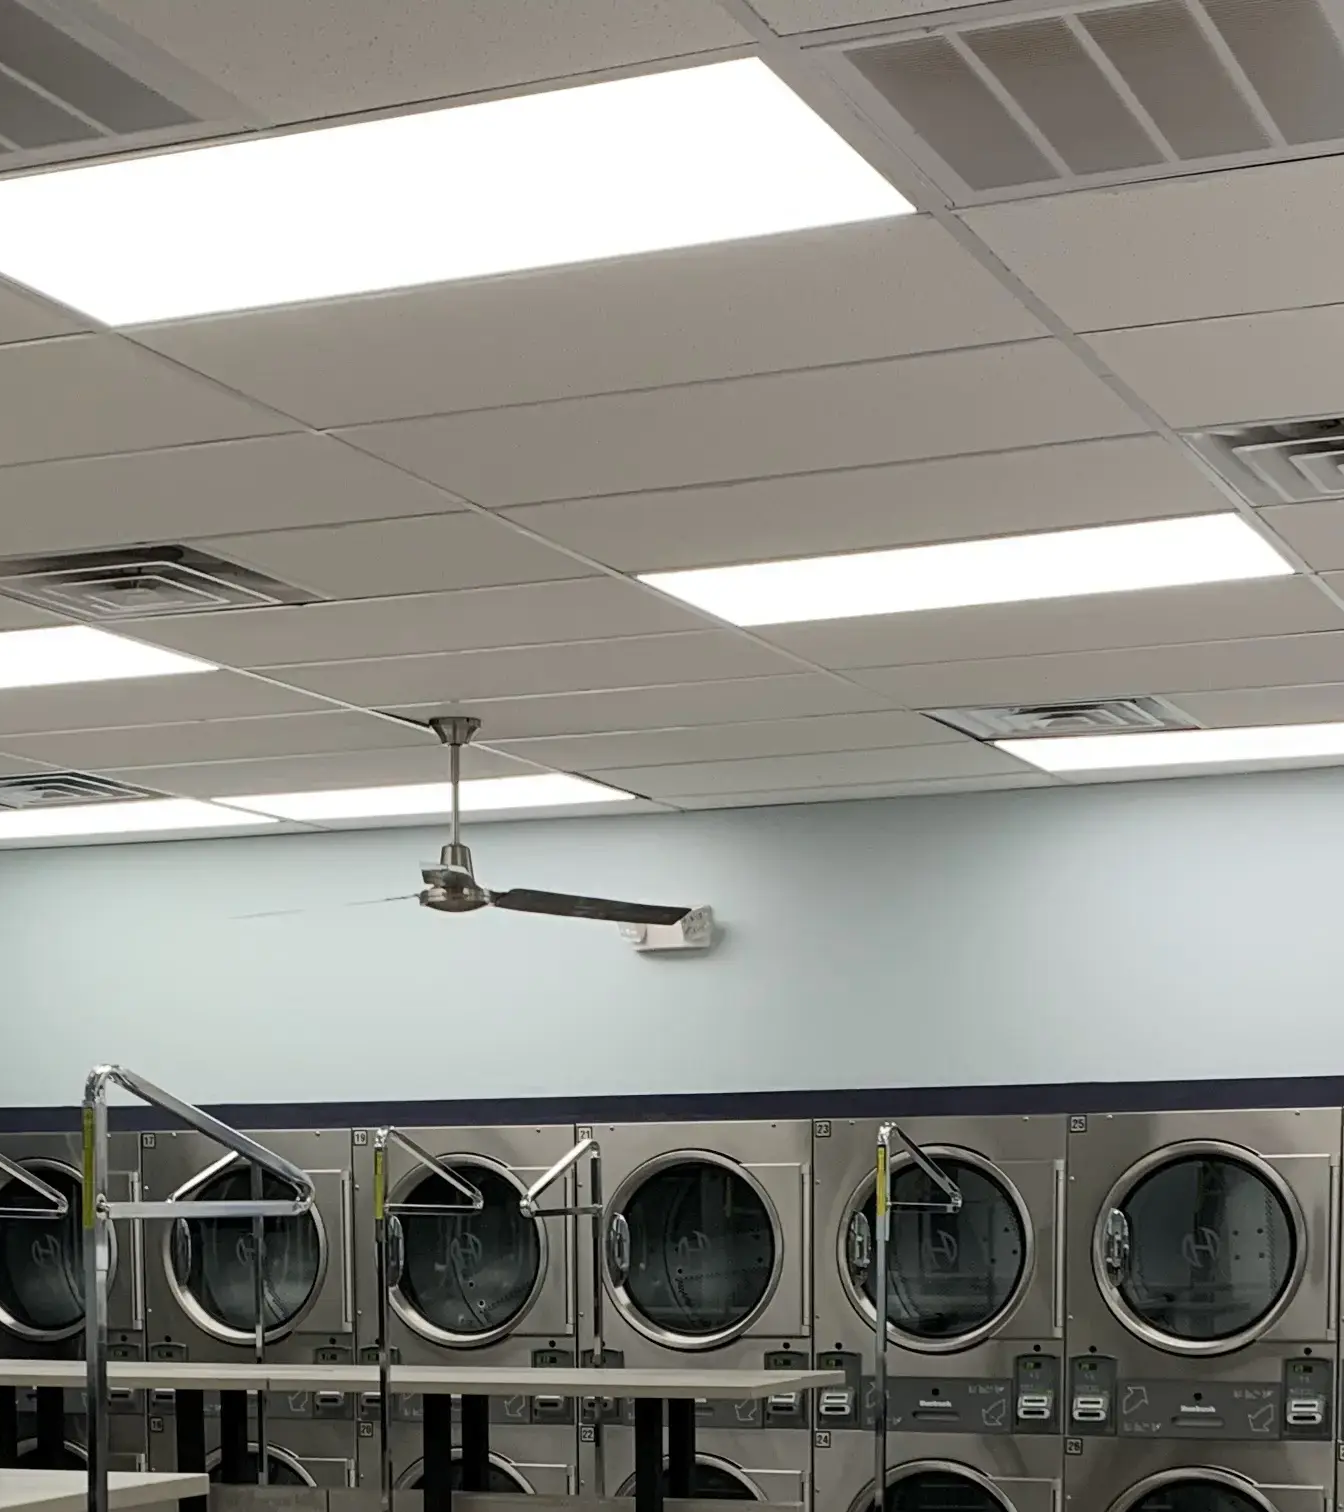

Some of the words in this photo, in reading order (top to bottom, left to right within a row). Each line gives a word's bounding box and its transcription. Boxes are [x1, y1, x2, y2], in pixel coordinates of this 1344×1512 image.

[1072, 1118, 1085, 1129] 25
[817, 1125, 829, 1134] 23
[355, 1133, 365, 1142] 19
[581, 1130, 590, 1139] 21
[144, 1136, 154, 1145] 17
[361, 1425, 371, 1434] 20
[582, 1430, 593, 1439] 22
[817, 1435, 828, 1444] 24
